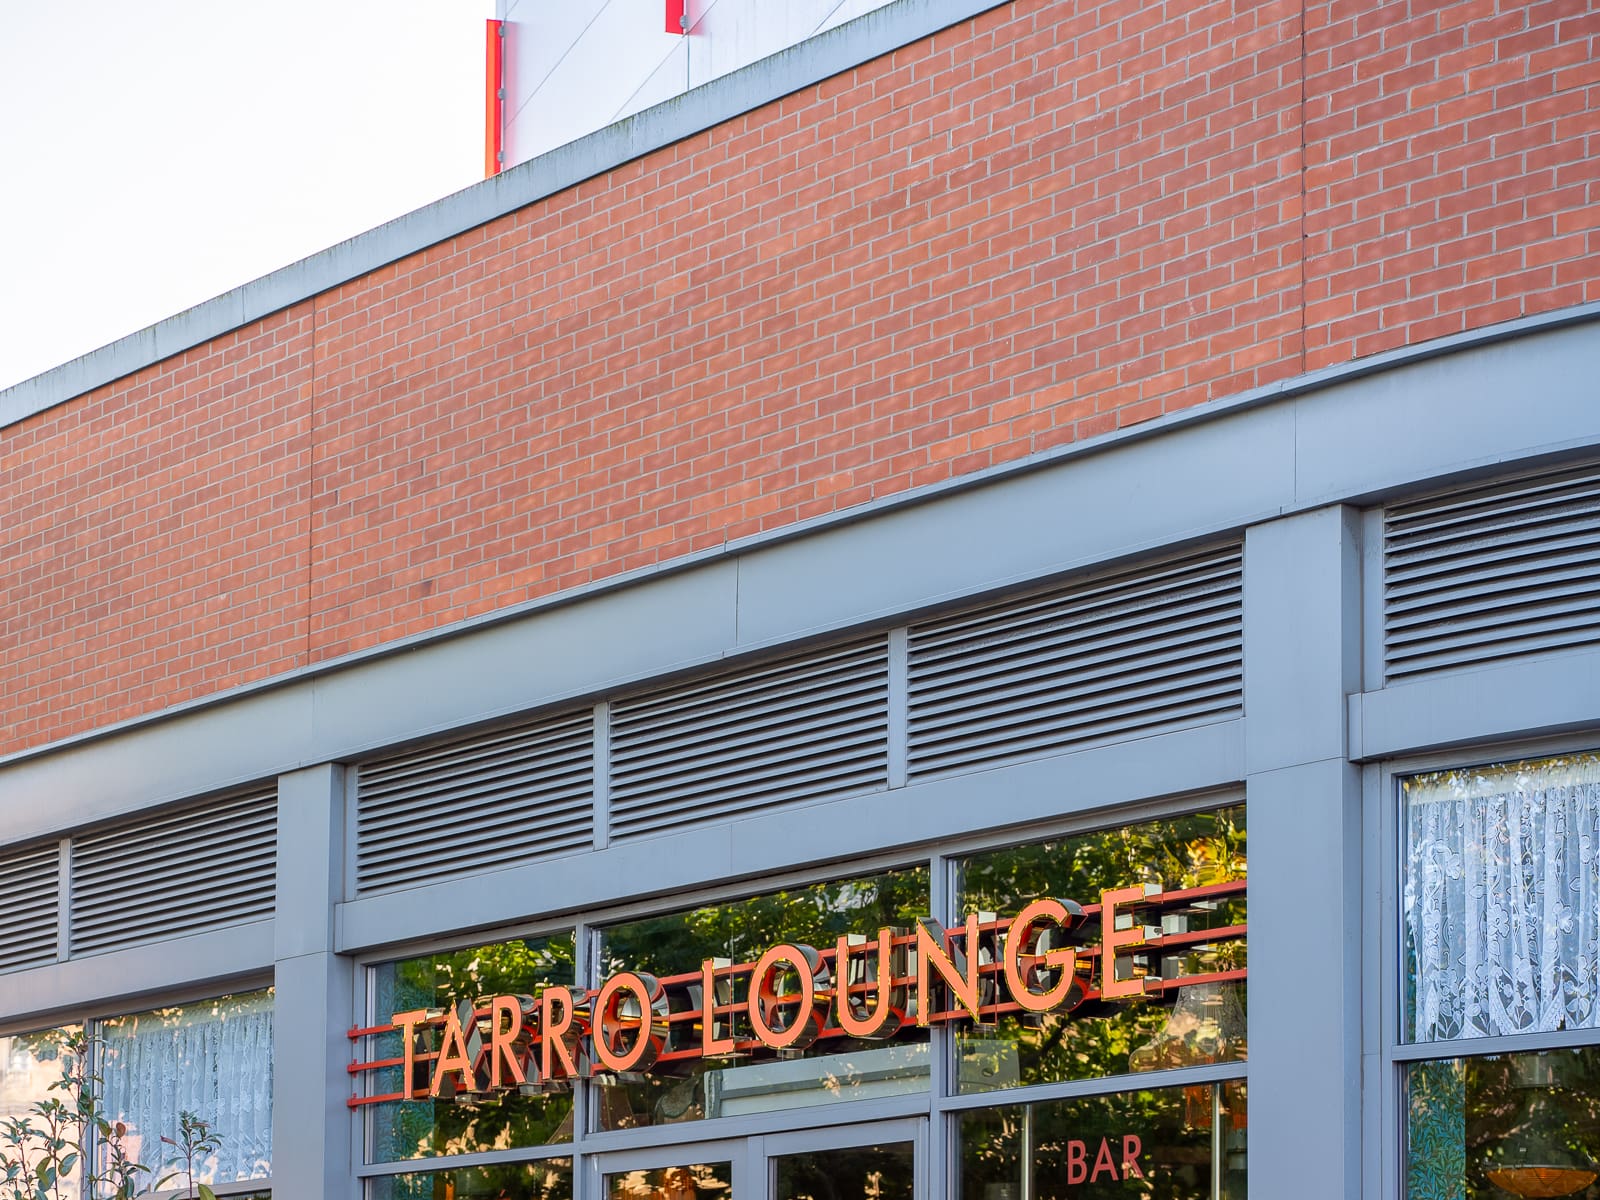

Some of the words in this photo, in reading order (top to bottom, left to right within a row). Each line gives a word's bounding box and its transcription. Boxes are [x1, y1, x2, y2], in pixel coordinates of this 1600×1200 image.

[392, 972, 652, 1100] TARRO
[701, 883, 1147, 1058] LOUNGE
[1067, 1133, 1144, 1185] BAR
